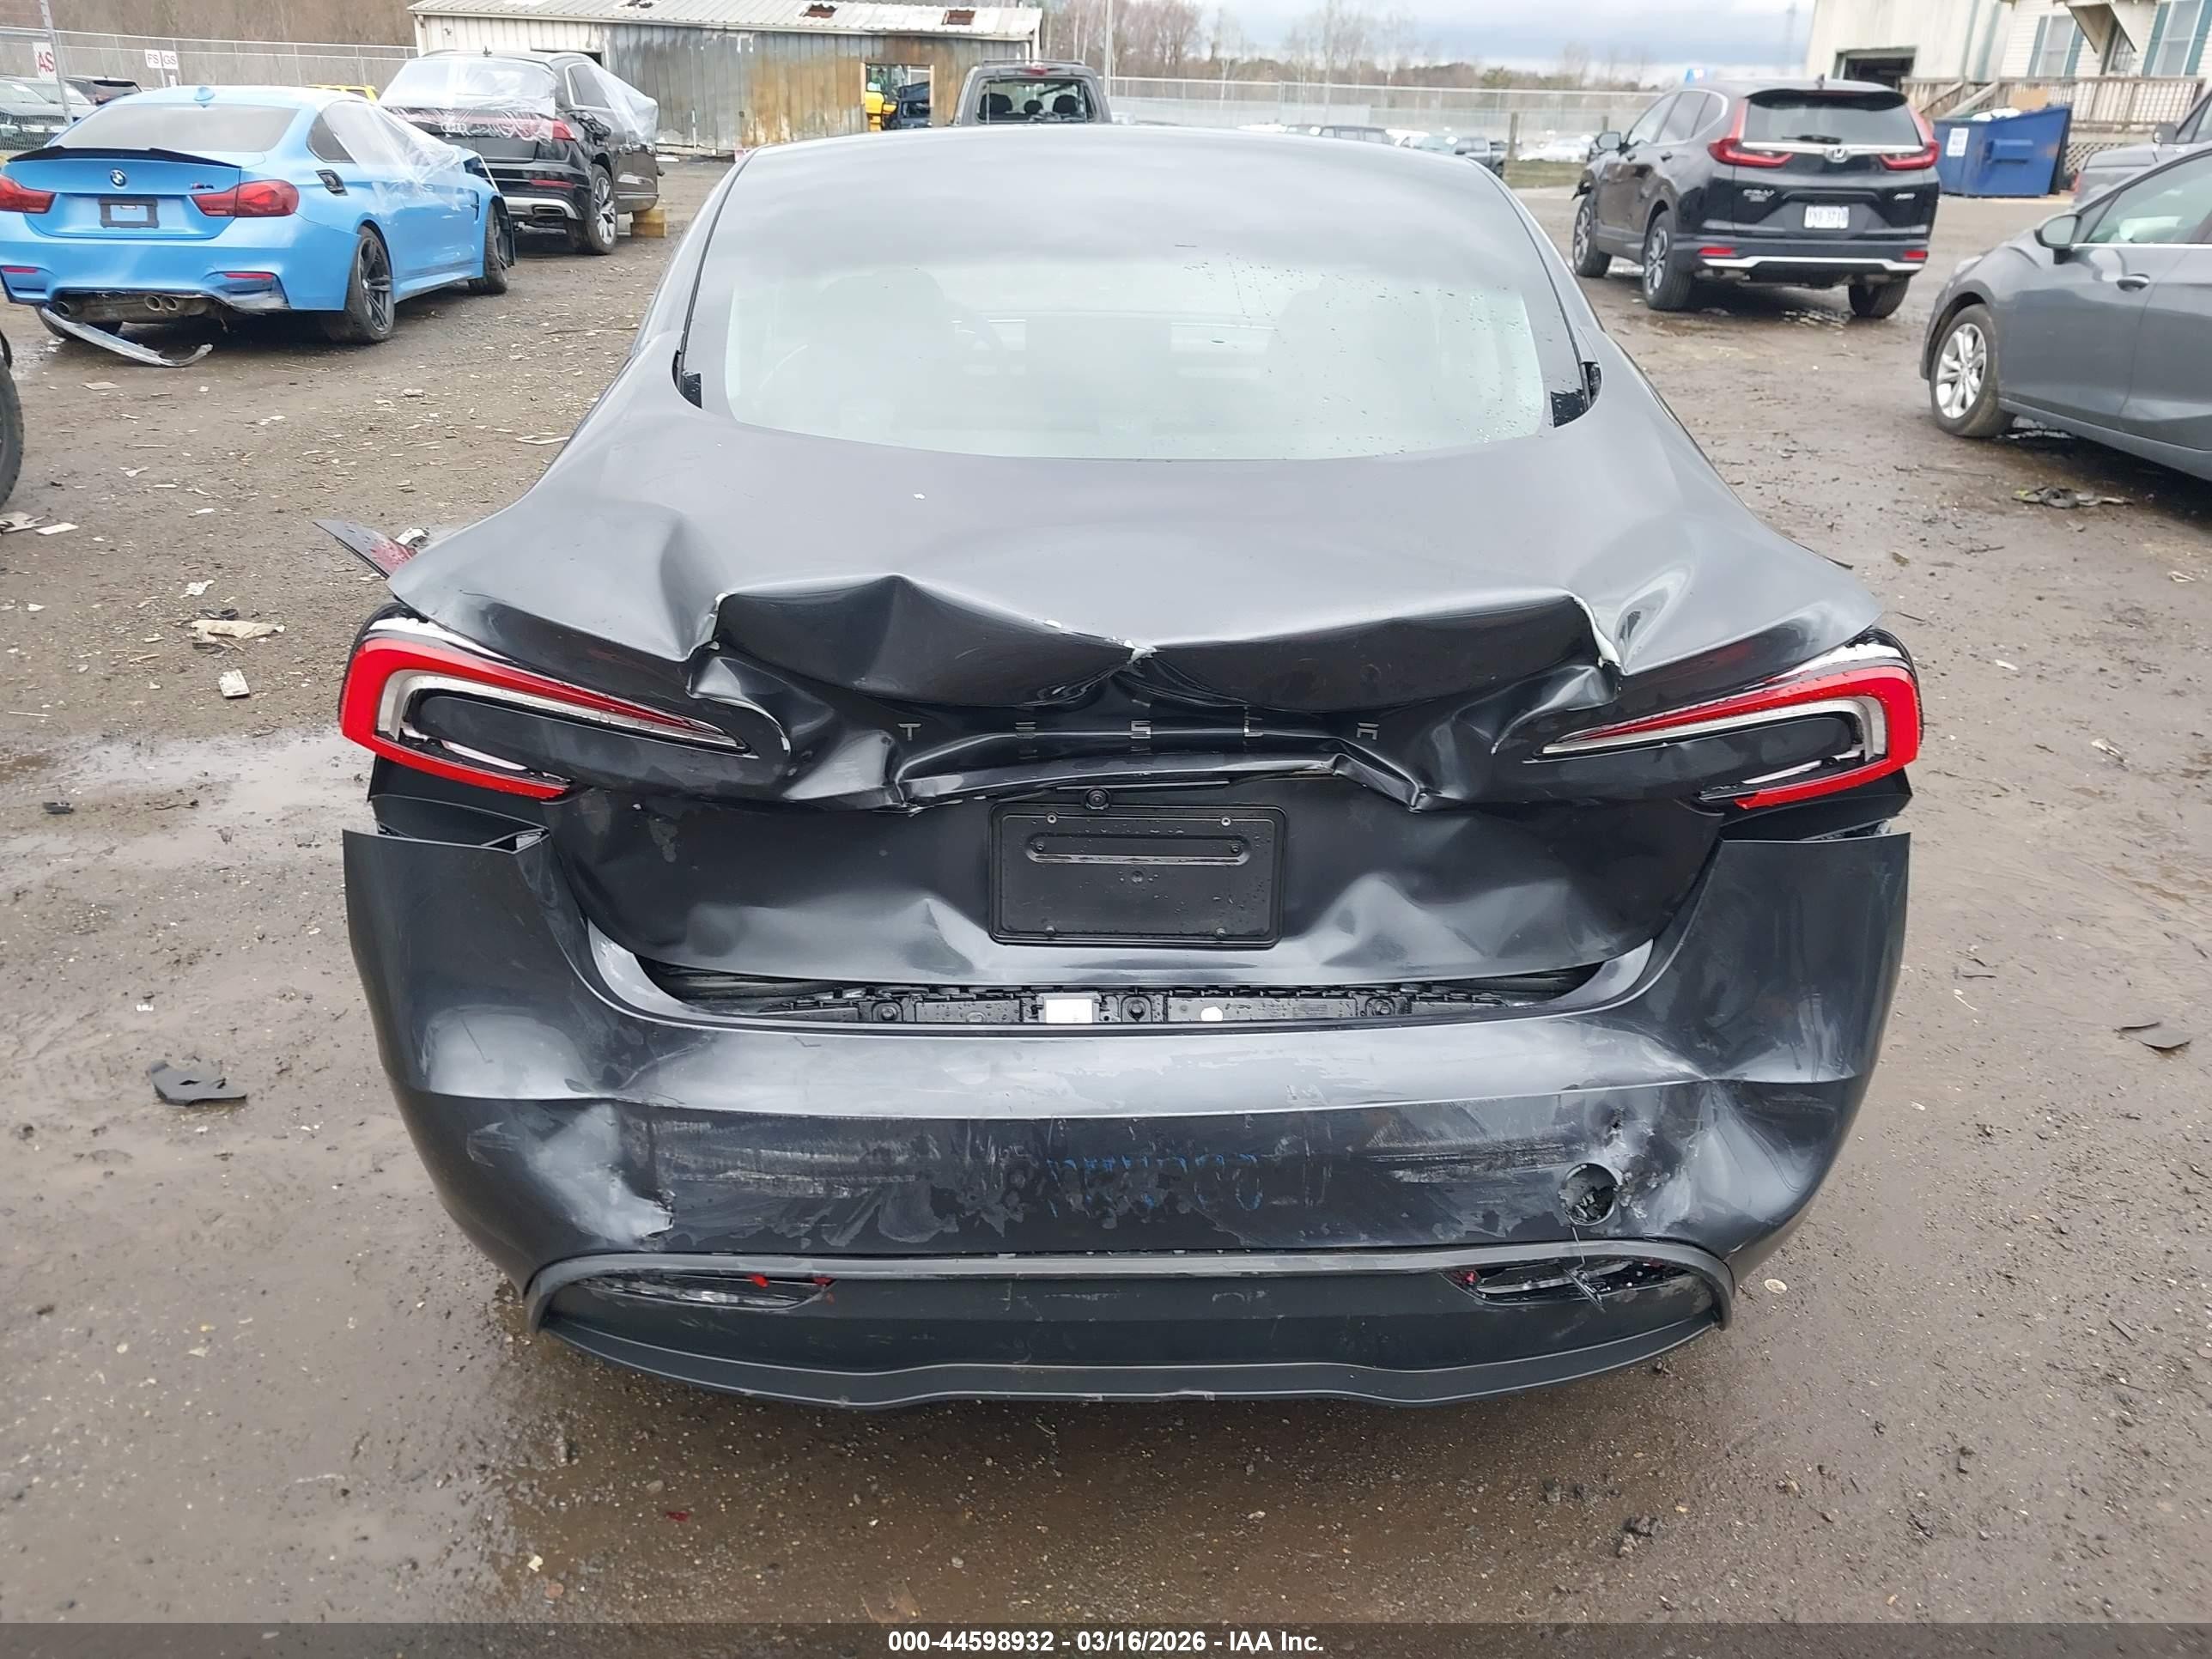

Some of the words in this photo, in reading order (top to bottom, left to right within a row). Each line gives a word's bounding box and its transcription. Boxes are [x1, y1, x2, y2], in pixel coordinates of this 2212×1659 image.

[38, 51, 55, 72] AS
[147, 53, 159, 64] FS
[162, 54, 177, 65] GS
